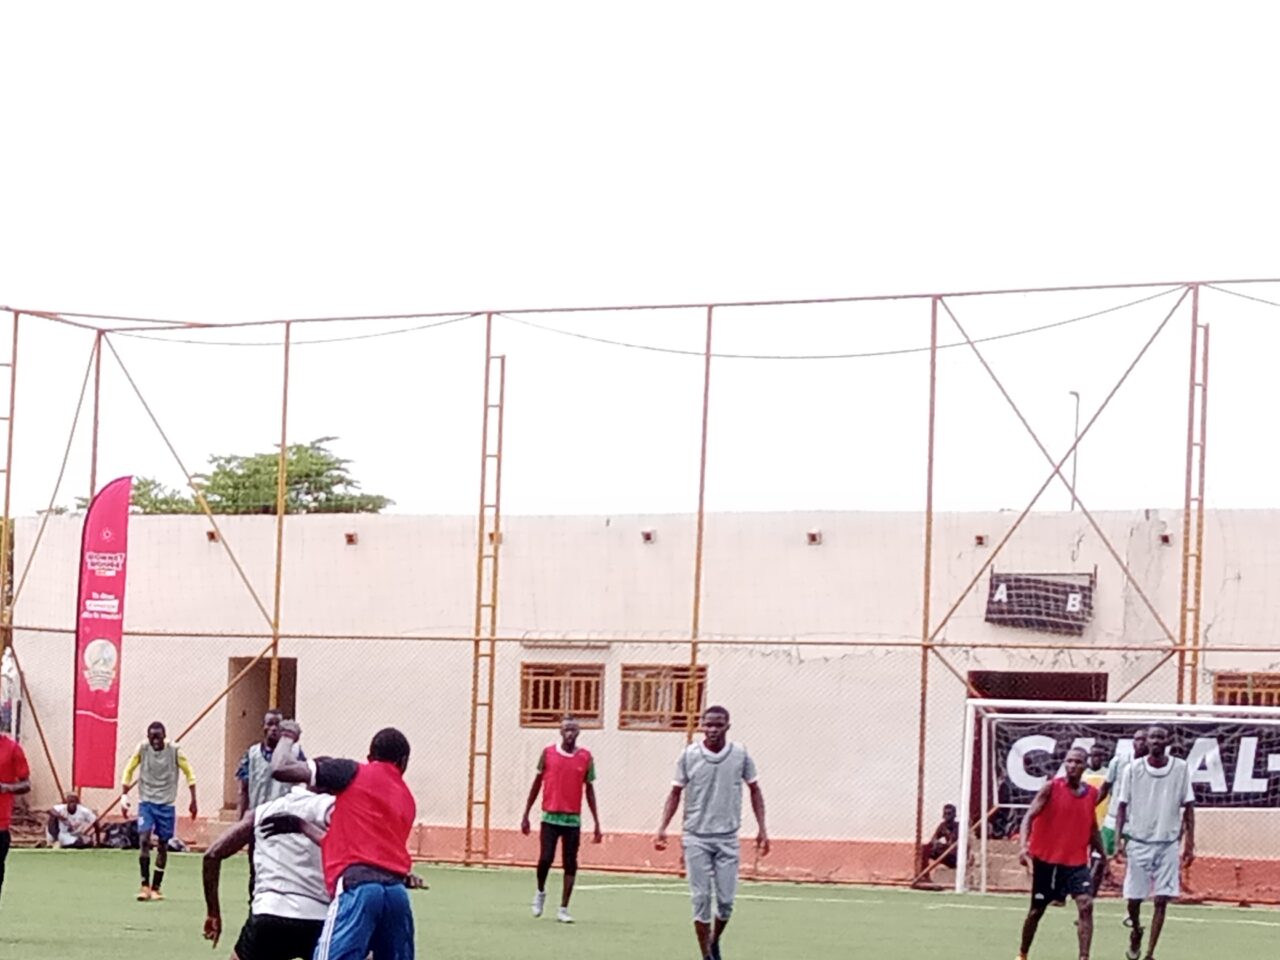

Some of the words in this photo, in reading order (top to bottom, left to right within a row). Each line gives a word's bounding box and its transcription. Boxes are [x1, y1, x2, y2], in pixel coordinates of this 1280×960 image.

[993, 583, 1008, 603] A
[1066, 593, 1082, 612] B
[1006, 734, 1280, 793] CAL
